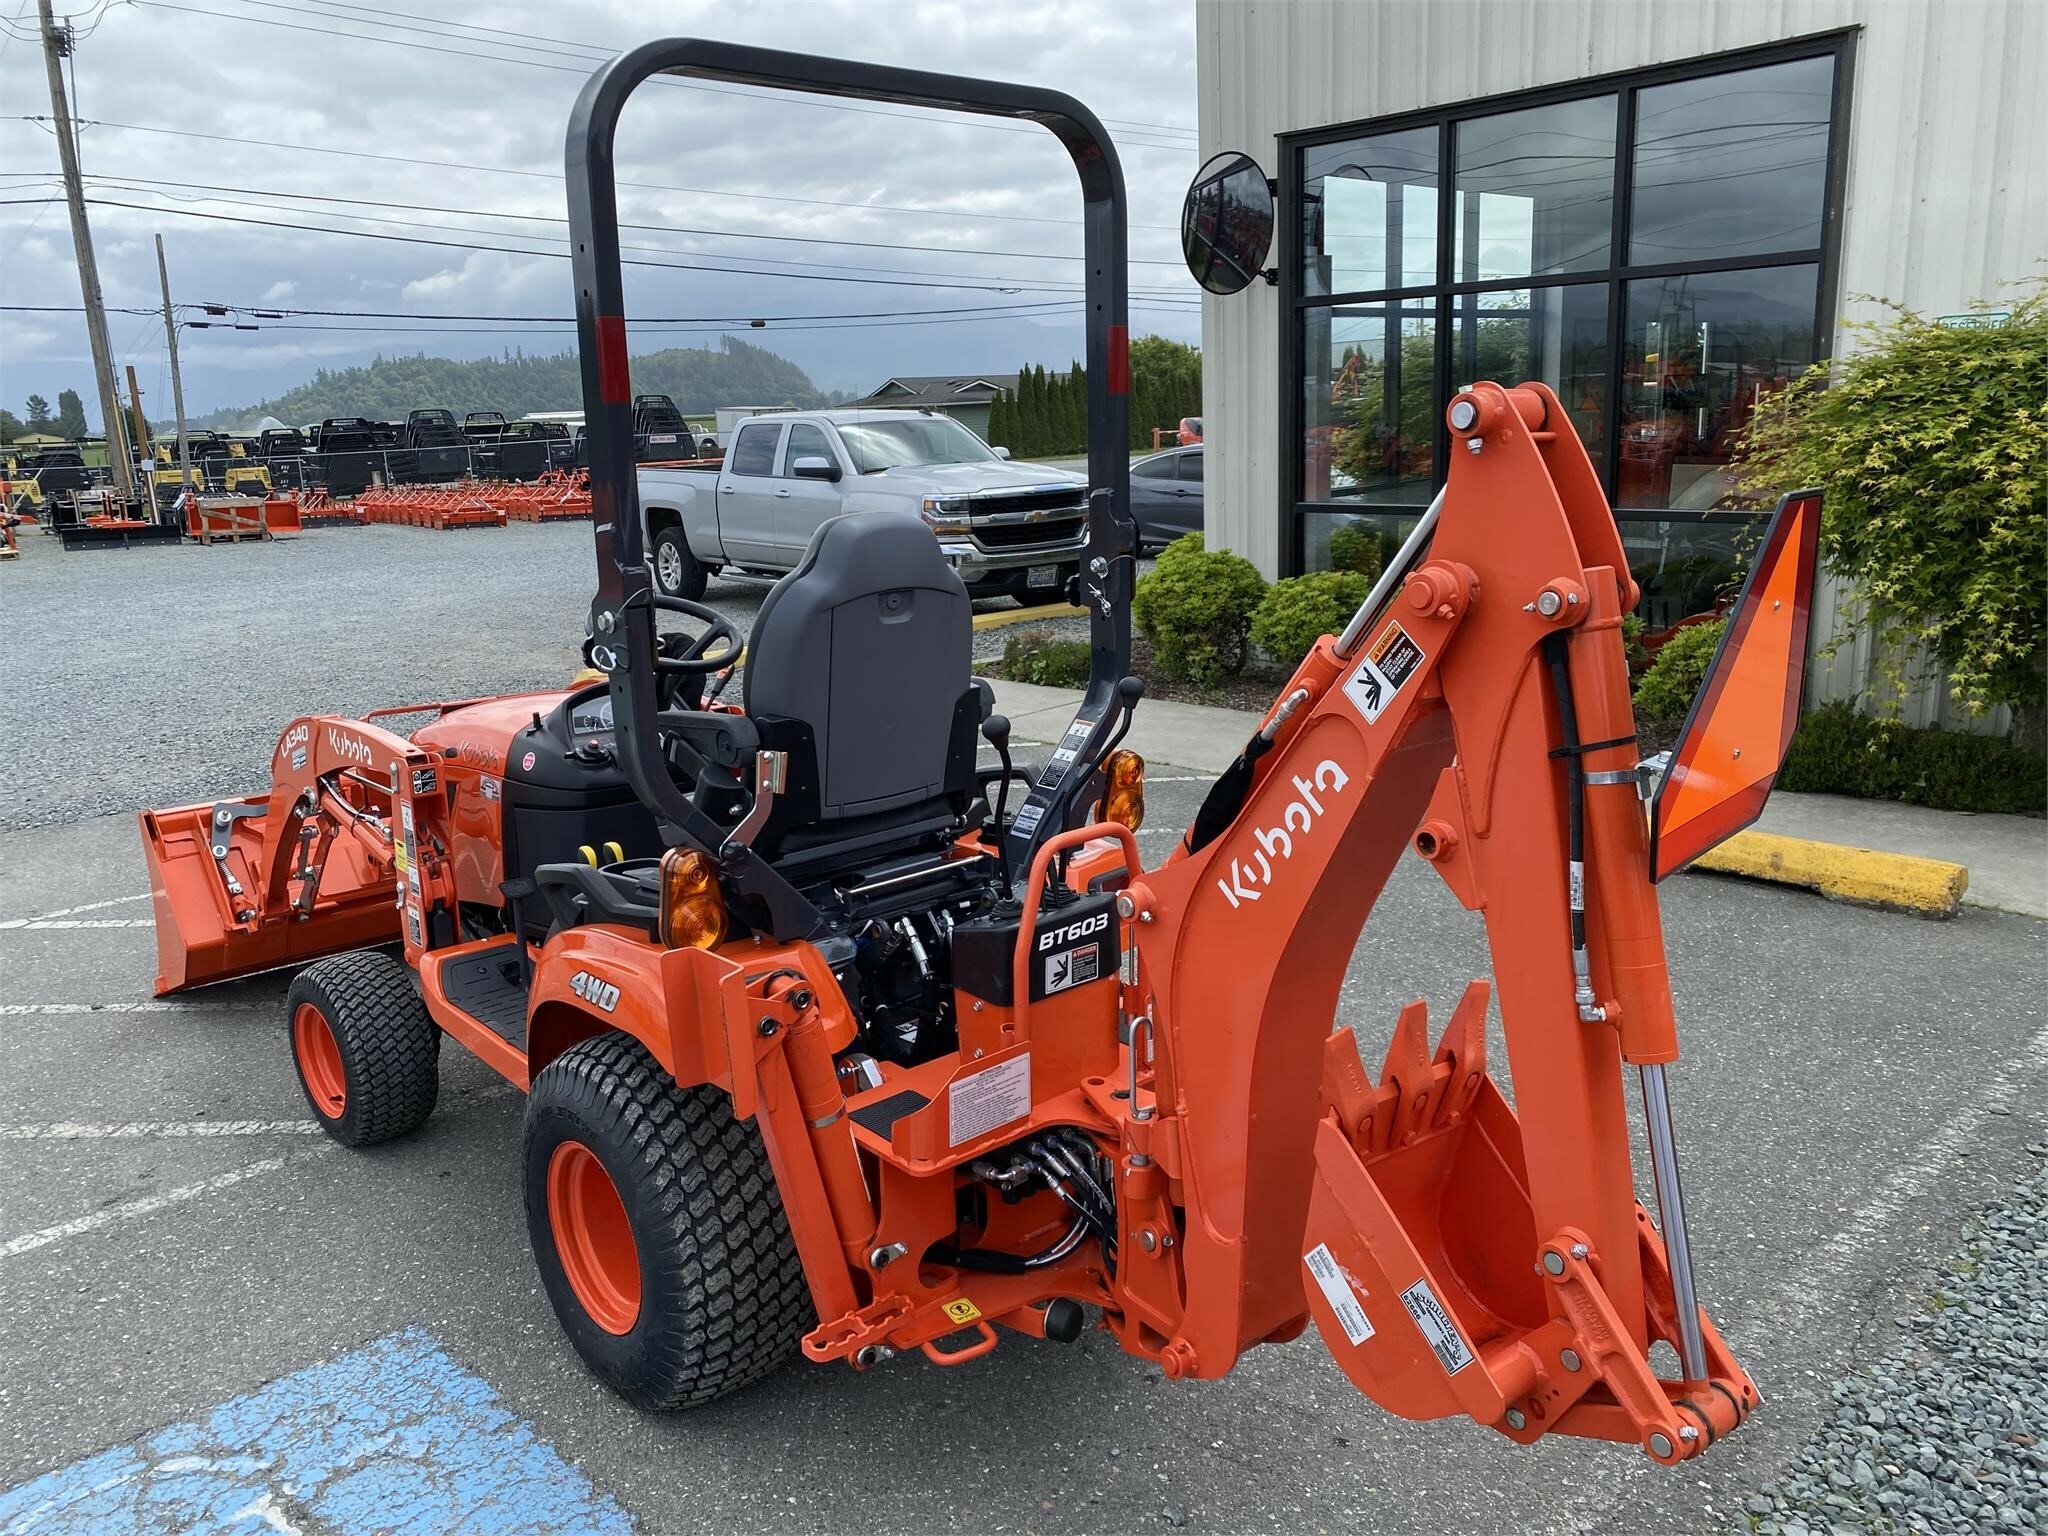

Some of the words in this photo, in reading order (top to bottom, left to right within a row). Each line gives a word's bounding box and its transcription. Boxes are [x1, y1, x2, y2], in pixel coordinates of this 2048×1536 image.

[1377, 628, 1398, 654] WARNING
[1391, 636, 1406, 654] PERSONAL
[281, 725, 309, 758] LA340
[328, 727, 373, 766] Kubota
[459, 740, 500, 770] Kubota
[1217, 759, 1349, 909] Kubota
[1038, 912, 1109, 951] BT603
[569, 969, 621, 1013] 4WD
